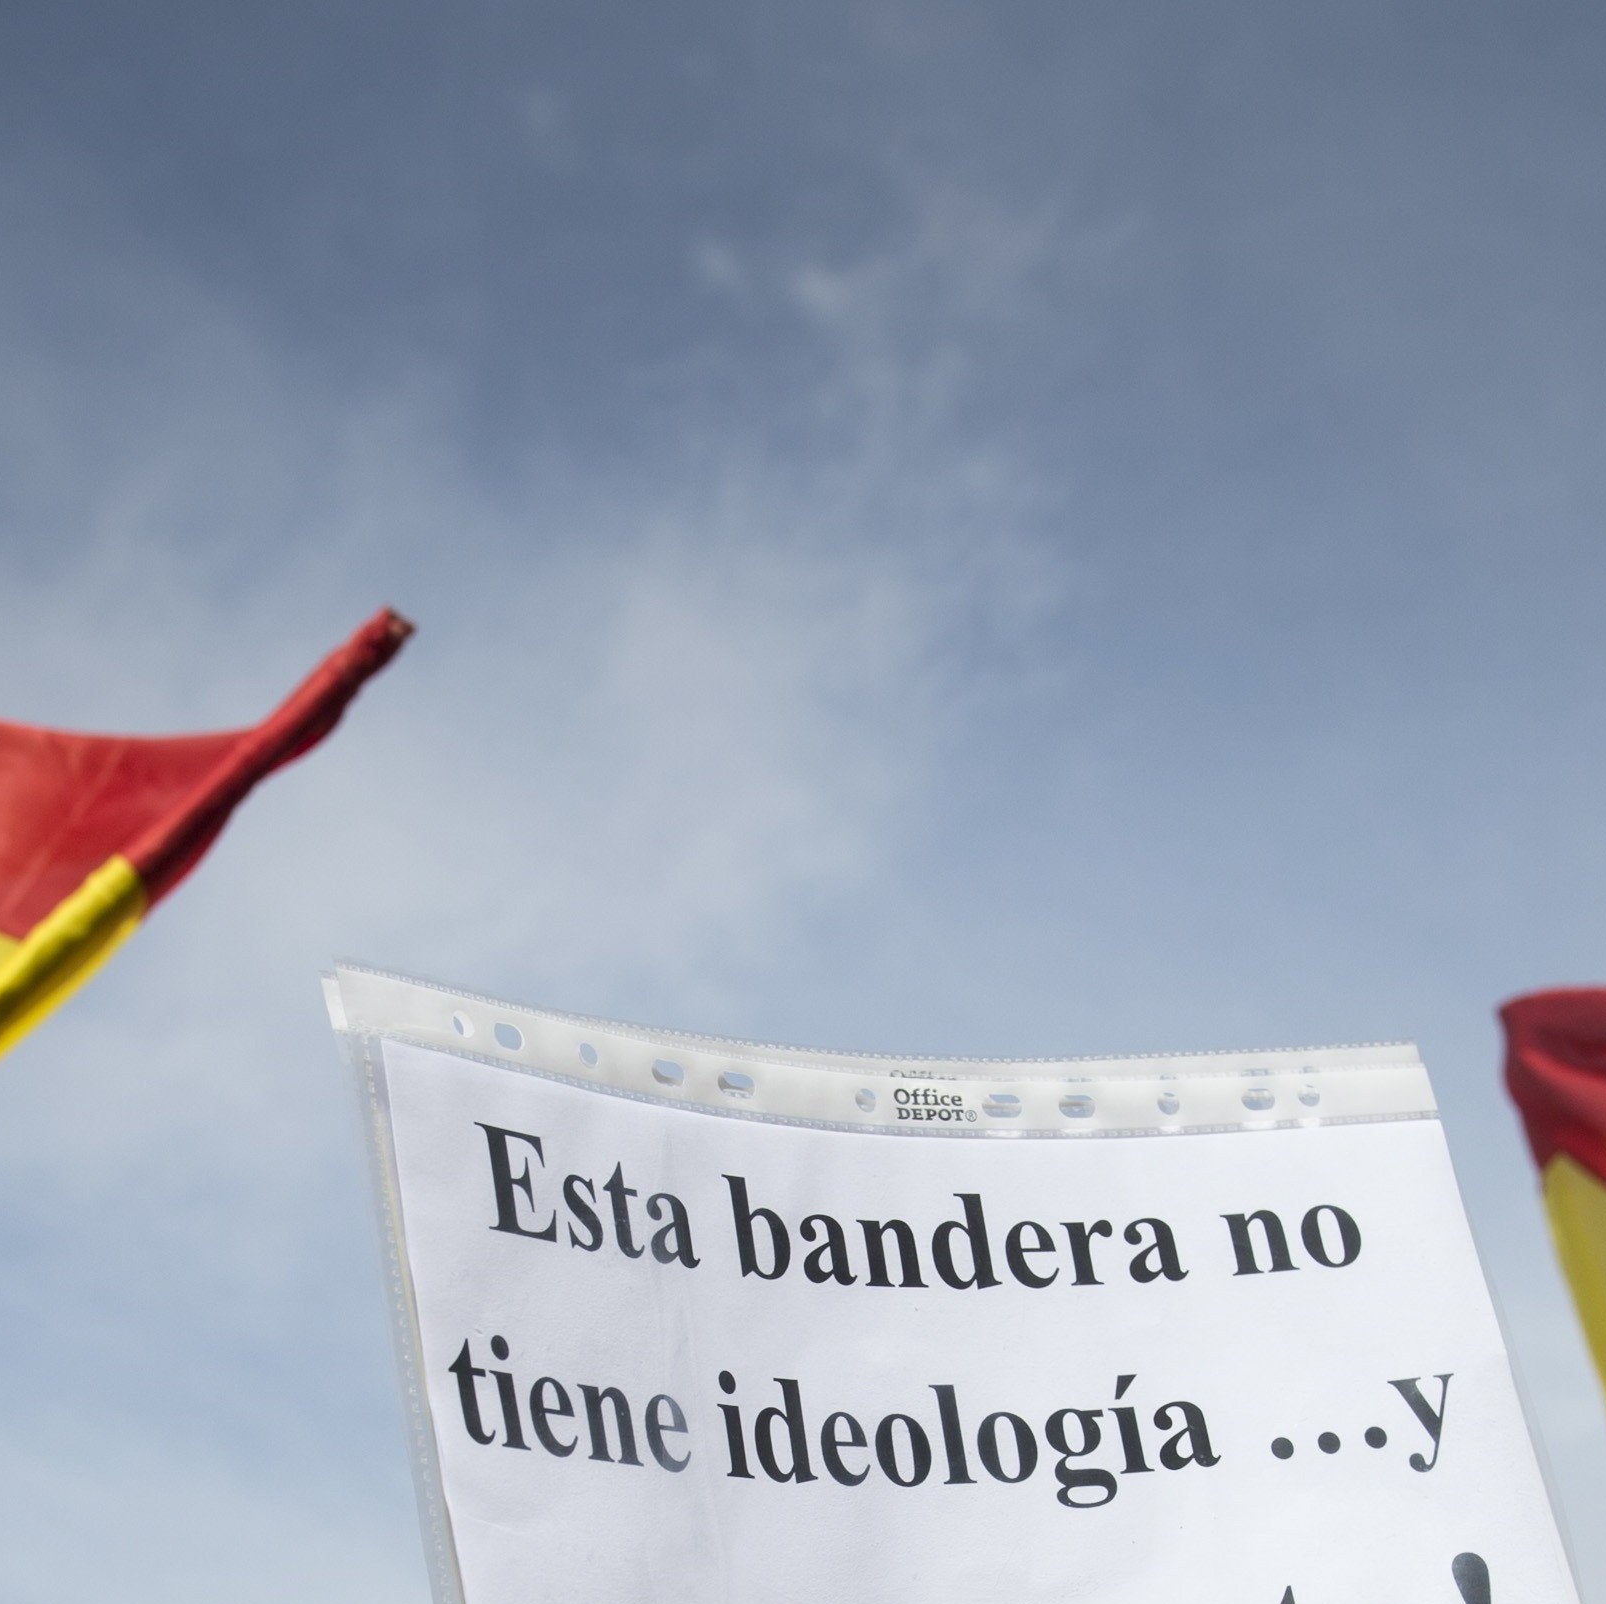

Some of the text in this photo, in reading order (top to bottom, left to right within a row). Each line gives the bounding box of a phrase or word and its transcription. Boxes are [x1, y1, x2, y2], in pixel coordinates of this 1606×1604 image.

[893, 1087, 964, 1107] Office
[473, 1121, 1362, 1291] Esta bandera no
[447, 1334, 692, 1474] tiene
[716, 1369, 1222, 1509] ideología
